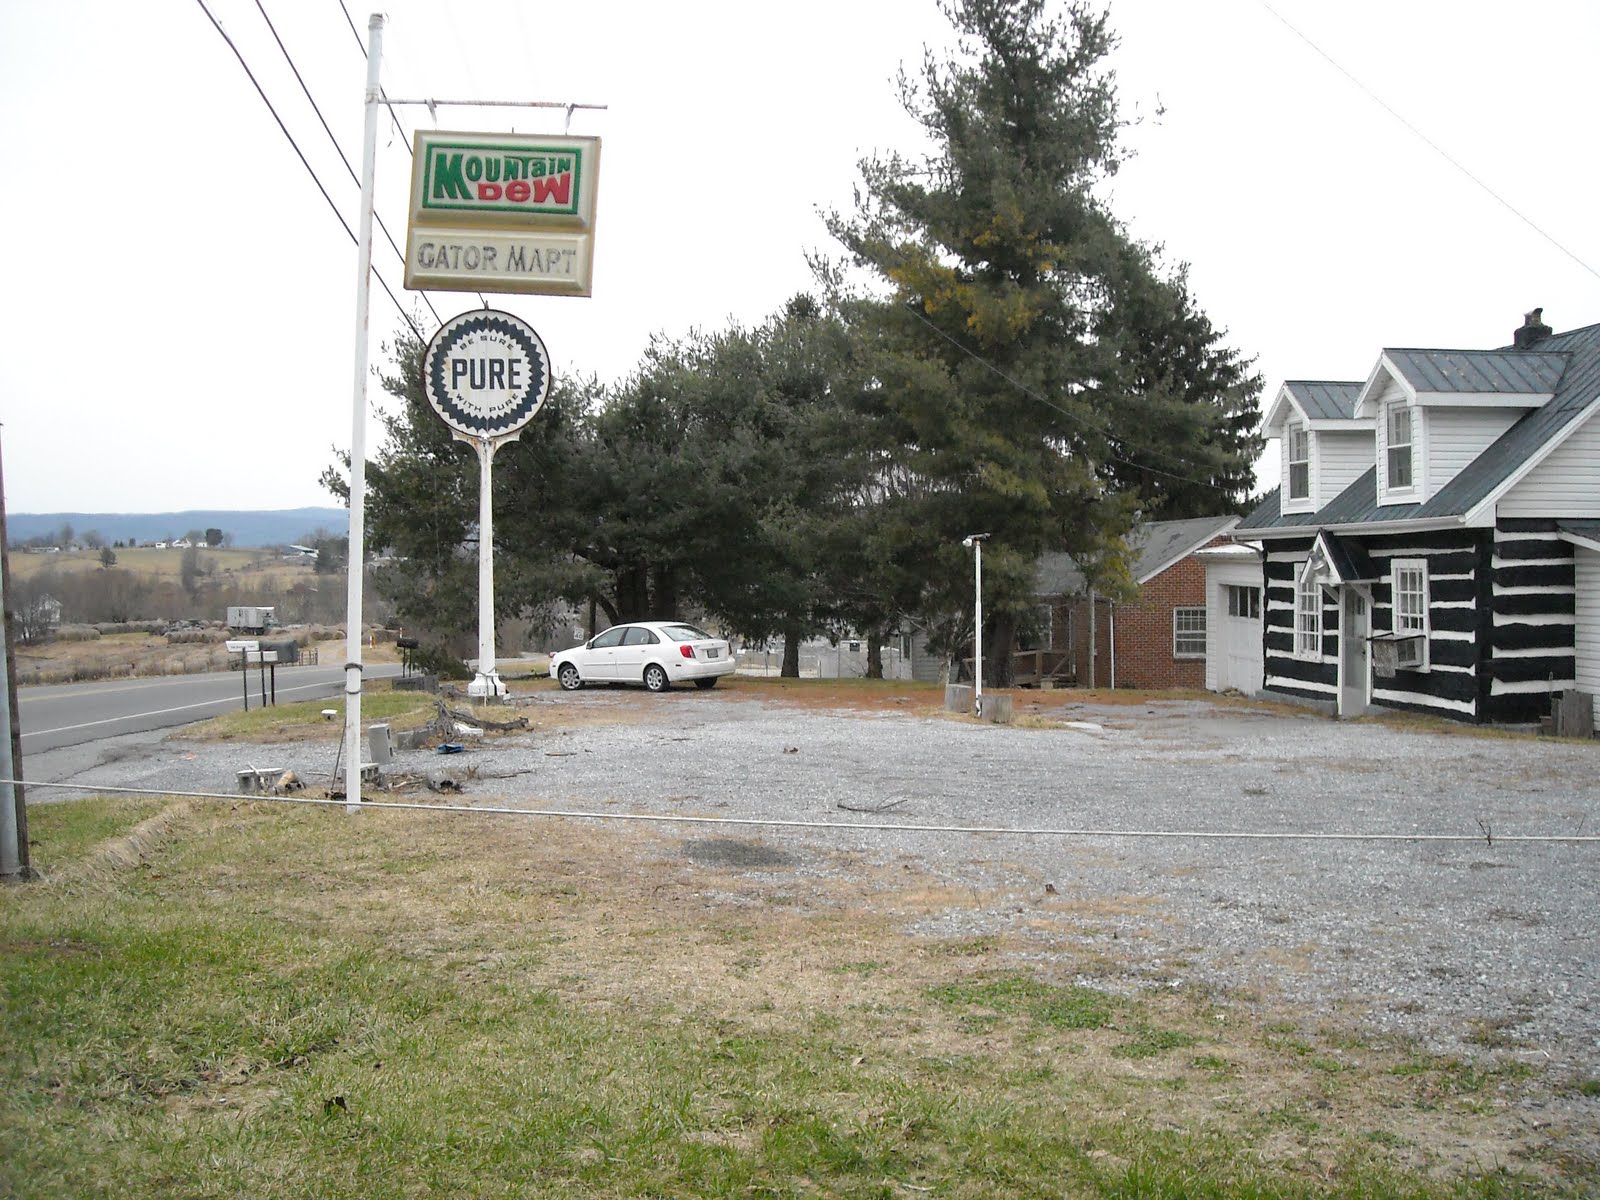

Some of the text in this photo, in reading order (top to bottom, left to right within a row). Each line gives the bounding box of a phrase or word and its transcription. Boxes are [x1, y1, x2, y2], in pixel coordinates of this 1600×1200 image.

[417, 242, 498, 271] GATOR
[459, 335, 515, 351] BE SURE
[451, 358, 522, 390] PURE
[456, 392, 519, 413] WITH PURE
